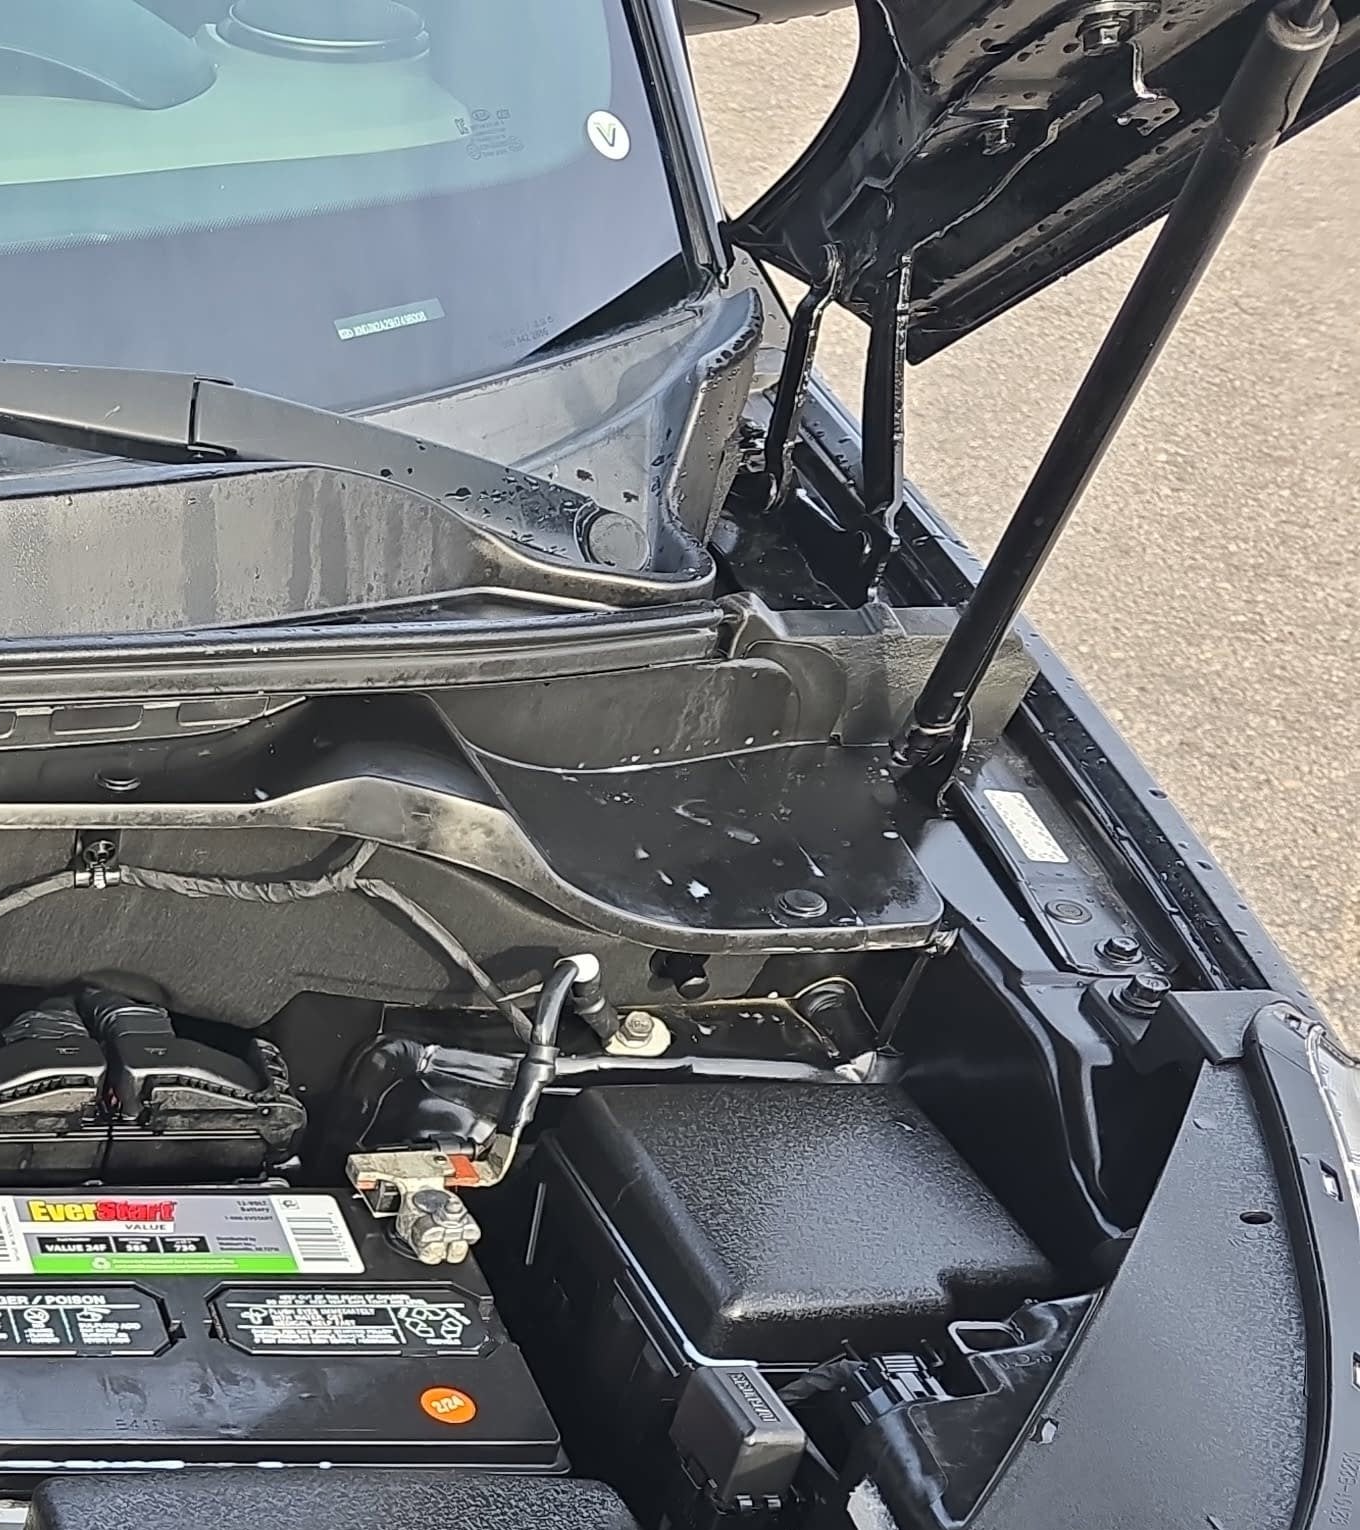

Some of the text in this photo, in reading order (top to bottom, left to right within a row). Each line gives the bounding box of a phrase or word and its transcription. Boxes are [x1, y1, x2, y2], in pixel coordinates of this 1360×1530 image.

[27, 1200, 175, 1222] EverStart
[45, 1244, 84, 1252] VALUE
[44, 1295, 106, 1305] POISON
